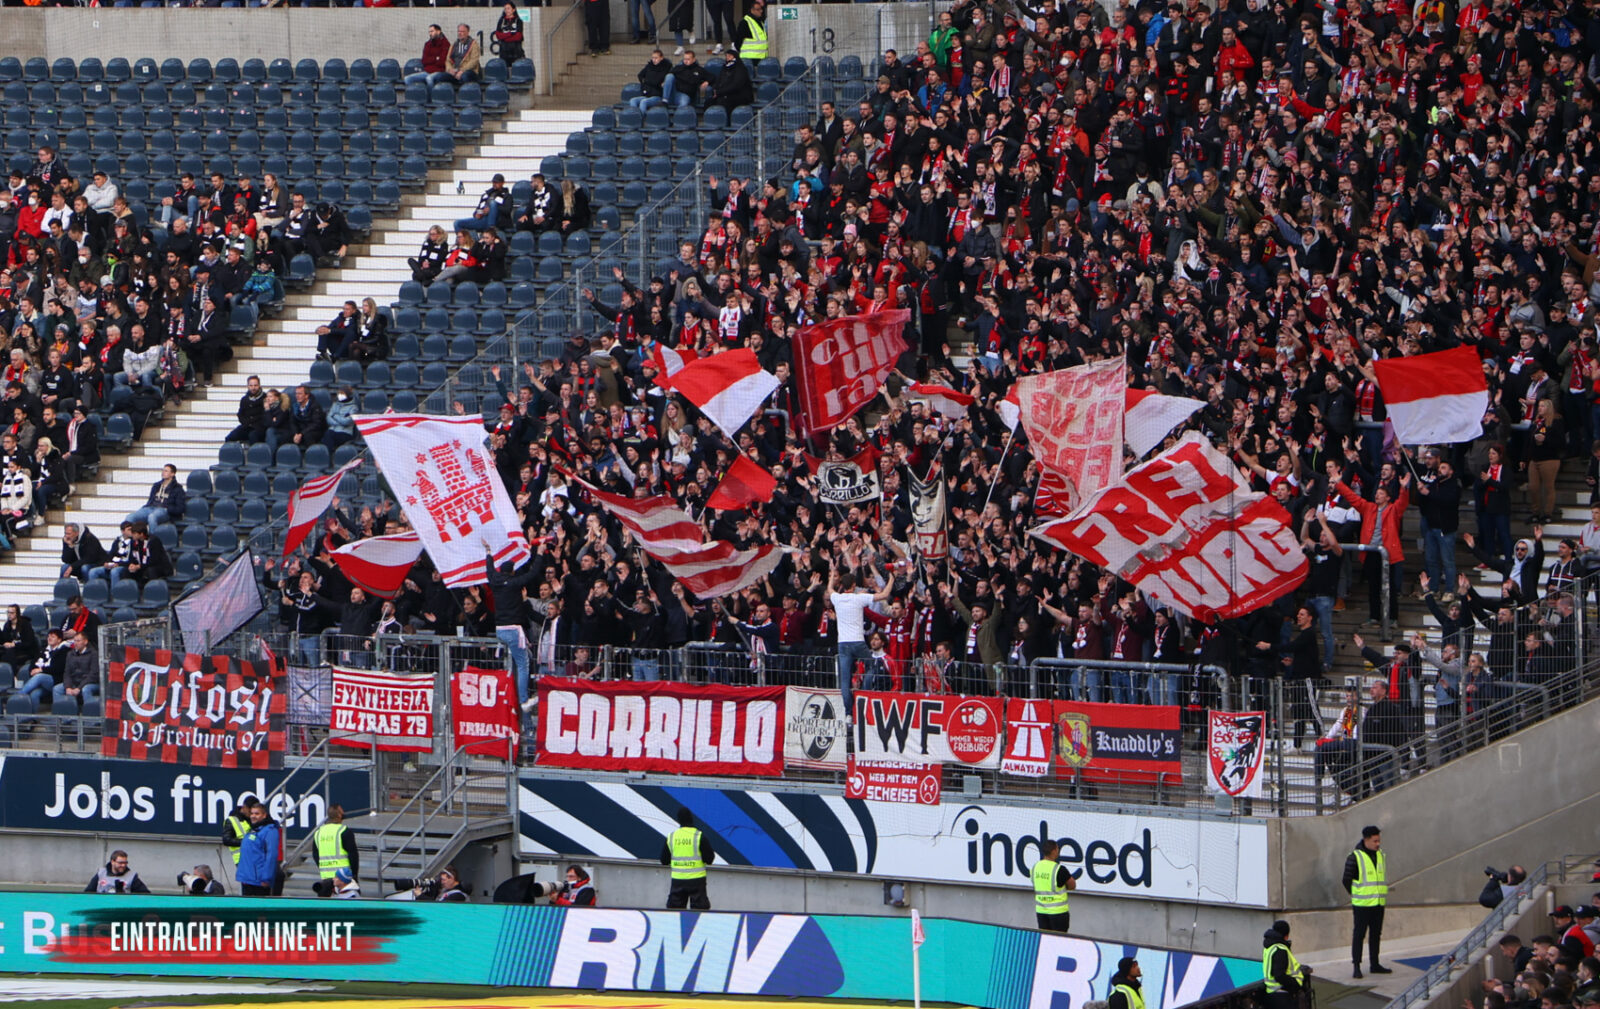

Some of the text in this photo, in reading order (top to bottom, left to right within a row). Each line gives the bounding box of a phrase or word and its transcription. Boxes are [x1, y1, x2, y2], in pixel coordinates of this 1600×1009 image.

[477, 30, 502, 55] 18
[809, 27, 835, 54] 18
[1043, 441, 1239, 568] FREI
[124, 661, 272, 725] Tifosi
[334, 682, 431, 711] SYNTHESIA
[335, 708, 427, 735] ULTRAS 79
[545, 690, 777, 764] CORRILLO
[856, 696, 945, 755] IWF
[122, 720, 267, 755] 19 Freiburg 97
[950, 735, 995, 744] IMMER WIEDER
[953, 742, 990, 753] FREIBURG
[1096, 730, 1175, 758] Knaddly's
[869, 772, 918, 785] WEG MIT DEM
[1004, 762, 1035, 774] ALWAYS
[45, 771, 155, 819] Jobs
[866, 785, 917, 803] SCHEISS
[965, 818, 1152, 888] indeed
[549, 907, 811, 994] RMV
